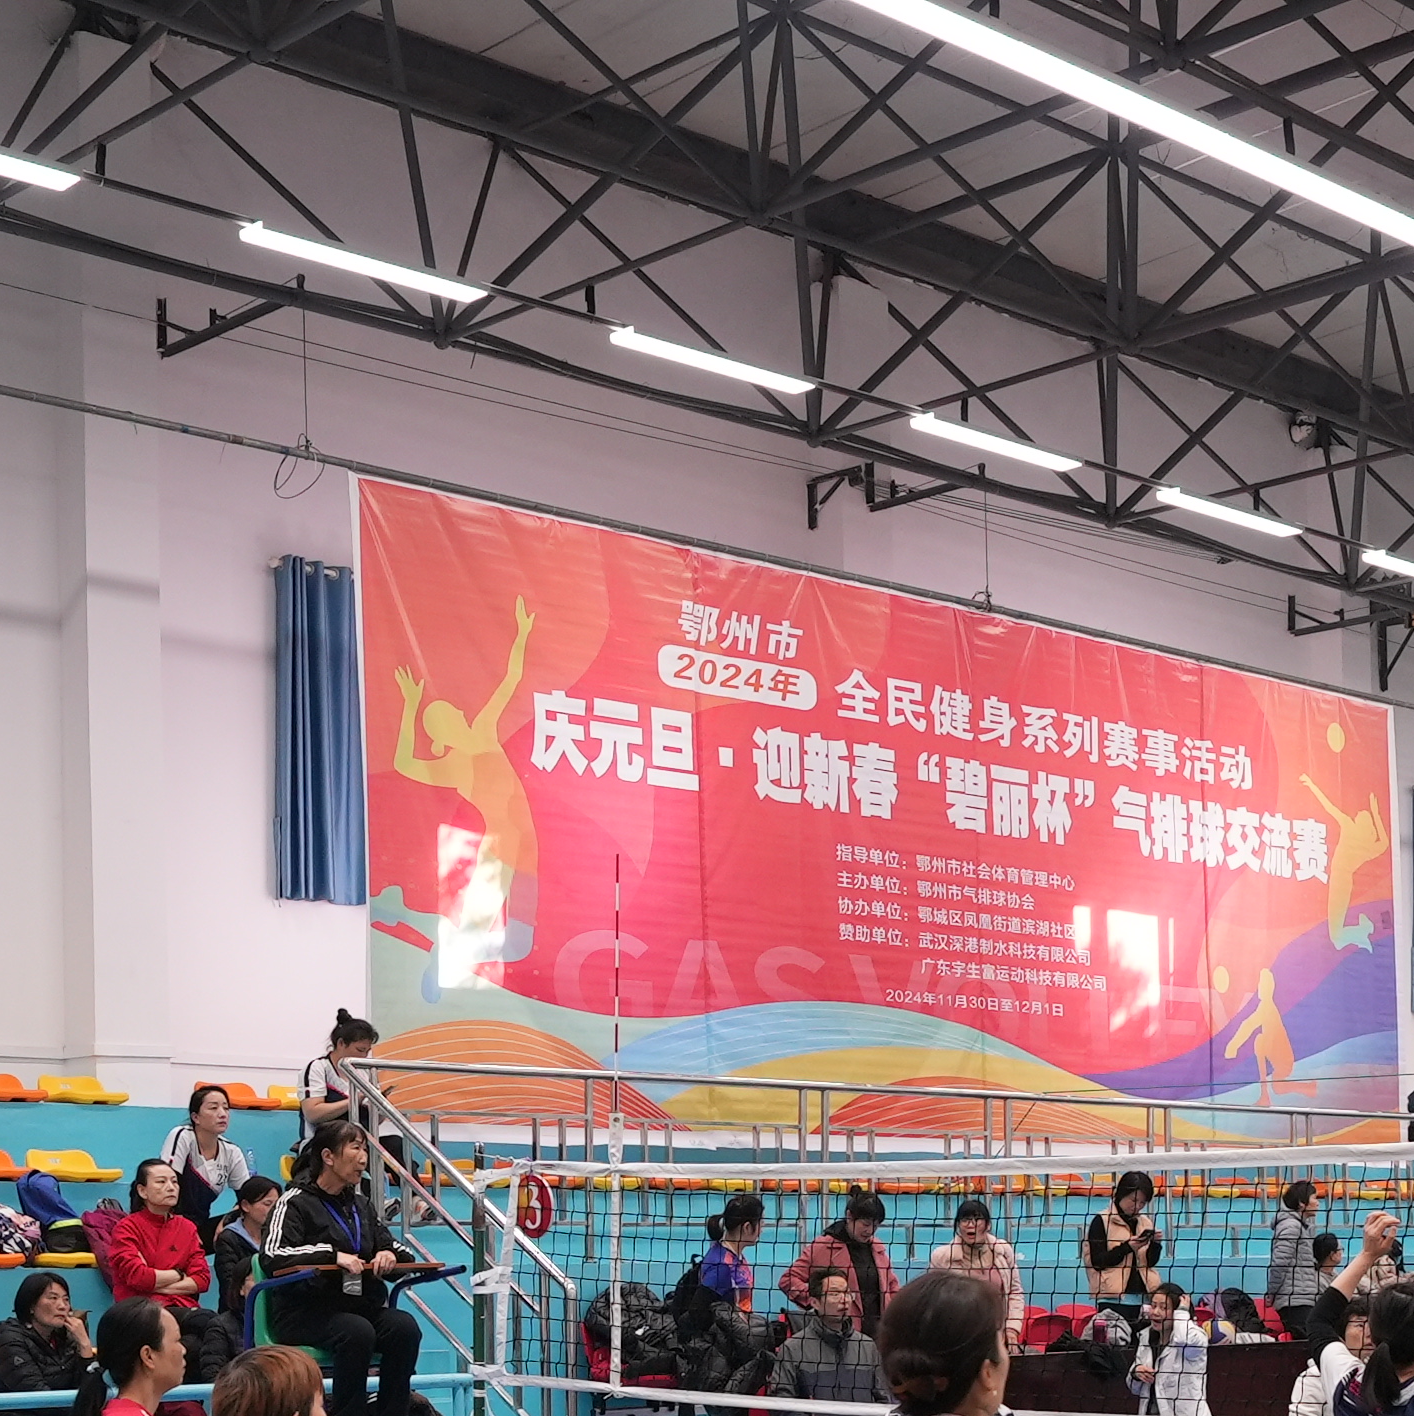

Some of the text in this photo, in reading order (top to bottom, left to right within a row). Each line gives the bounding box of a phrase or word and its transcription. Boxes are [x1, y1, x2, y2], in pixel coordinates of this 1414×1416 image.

[676, 600, 804, 661] 鄂州市
[673, 652, 801, 702] 2024年
[834, 668, 1254, 790] 全民健身系列赛事活动
[921, 956, 1108, 992] 广东宇生富运动科技有限公司
[884, 988, 1065, 1018] 2024年11月30日至12月1日
[524, 1181, 542, 1230] 3
